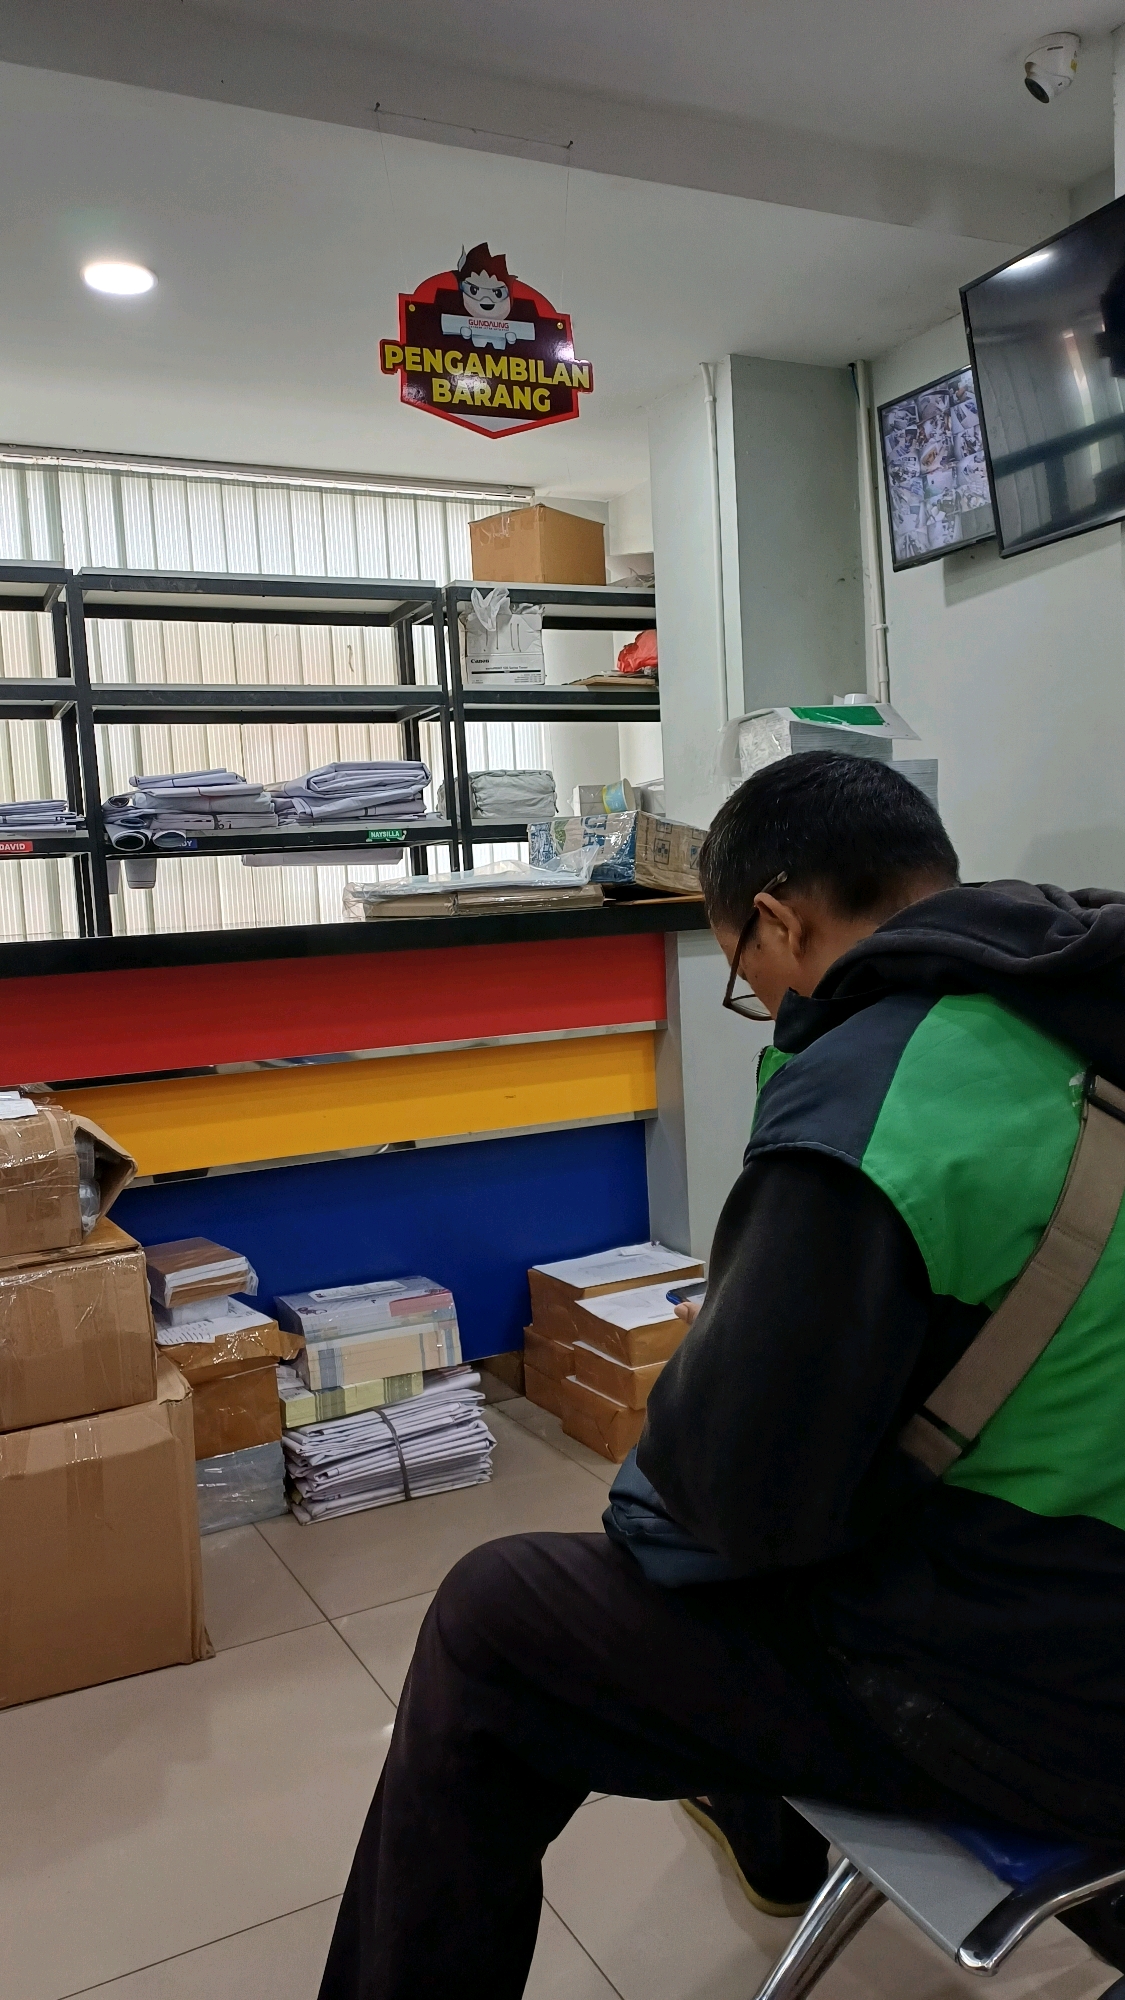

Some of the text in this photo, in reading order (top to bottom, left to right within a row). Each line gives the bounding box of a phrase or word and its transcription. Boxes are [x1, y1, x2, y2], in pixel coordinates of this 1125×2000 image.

[384, 344, 591, 389] PENGAMBILAN
[431, 377, 551, 412] BARANG
[370, 830, 400, 838] NAYSILLA
[0, 843, 26, 851] DAVID
